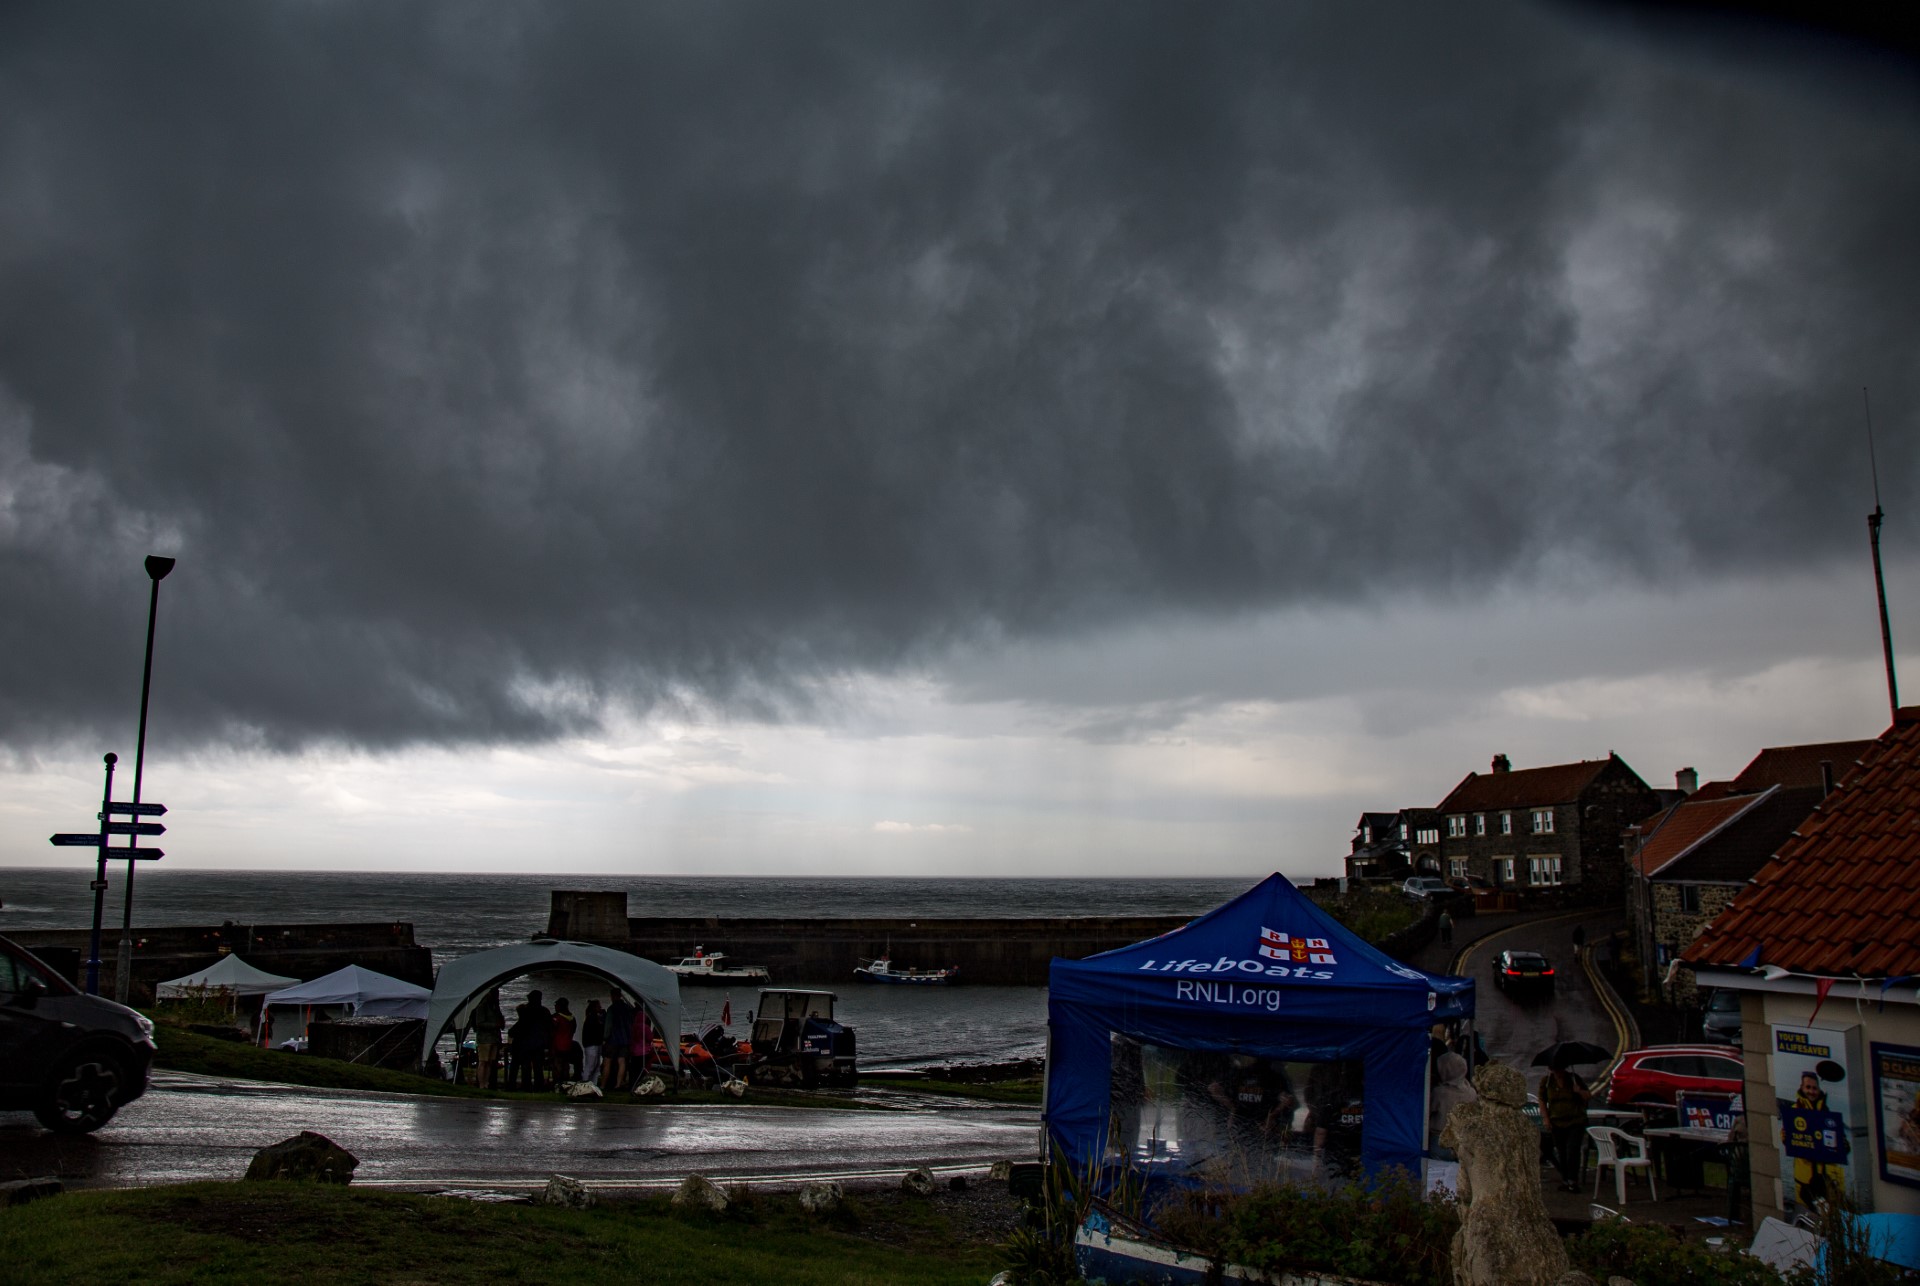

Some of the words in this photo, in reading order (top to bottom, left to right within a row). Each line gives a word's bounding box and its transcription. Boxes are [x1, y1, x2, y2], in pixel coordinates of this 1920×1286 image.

[1138, 956, 1334, 980] Lifeboats
[1176, 980, 1280, 1011] RNLI.org
[1778, 1032, 1806, 1043] YOU'RE
[1786, 1043, 1829, 1056] LIFESAVER
[1238, 1092, 1263, 1103] CREW
